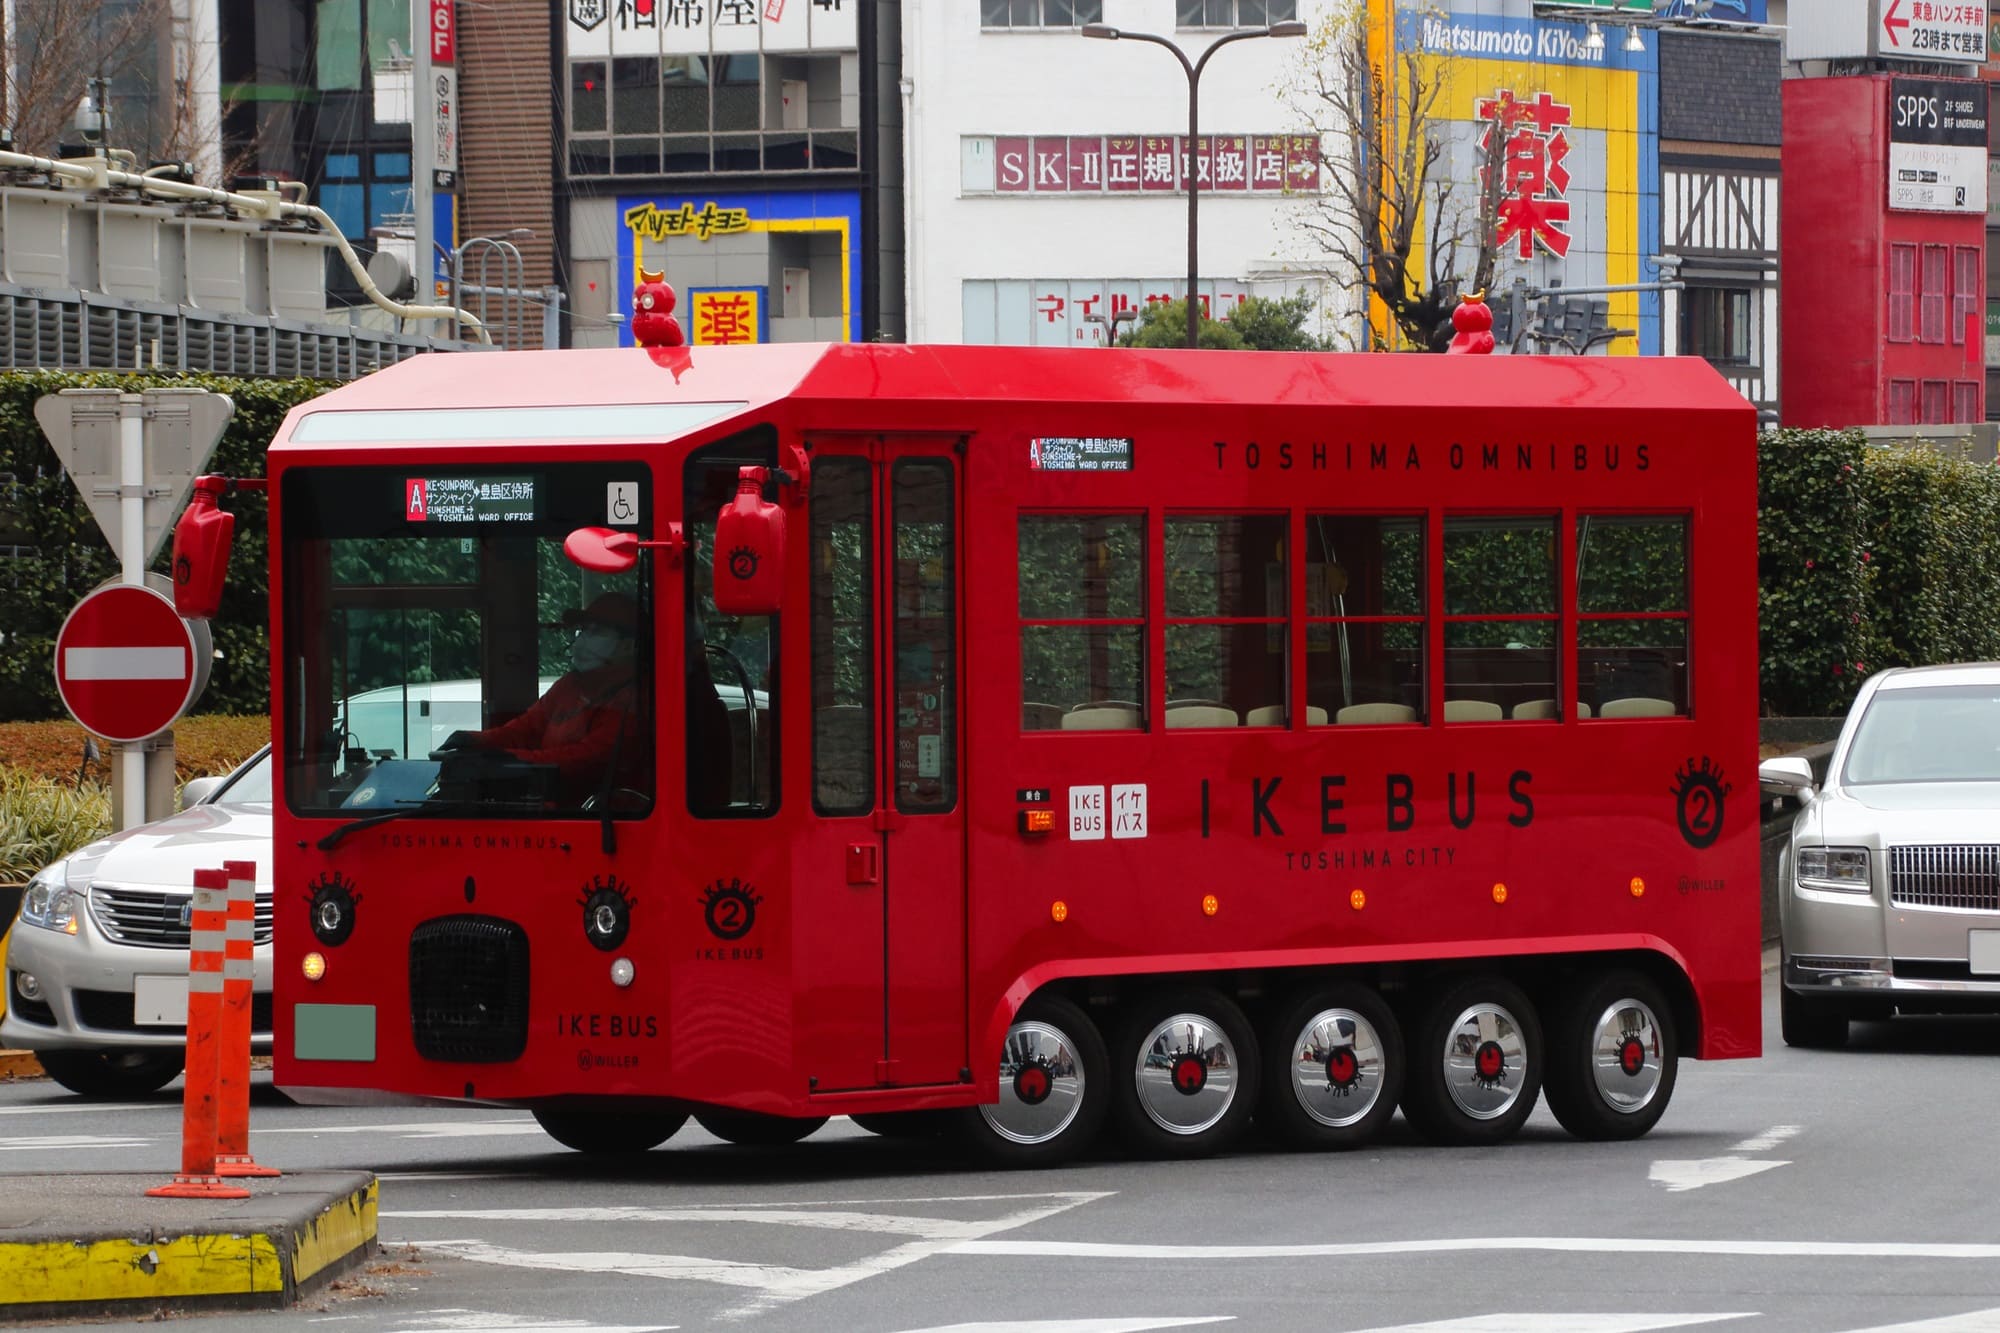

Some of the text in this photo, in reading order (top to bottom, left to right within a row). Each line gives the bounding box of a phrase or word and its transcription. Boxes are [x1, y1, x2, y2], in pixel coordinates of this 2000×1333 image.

[1912, 2, 1984, 26] 東急ハンズ手前
[1423, 18, 1533, 55] Matsumoto
[1912, 28, 1983, 54] 23時まで営業
[1897, 95, 1974, 128] SPPS 2F SHOES
[1476, 88, 1571, 261] 薬
[700, 294, 751, 345] 薬
[1213, 442, 1650, 471] TOSHIMA OMNIBUS
[410, 484, 423, 513] A
[426, 492, 475, 504] サンシャイン
[480, 483, 533, 500] 豊島区役所
[426, 506, 465, 514] SUNSHINE
[479, 513, 500, 521] WARD
[504, 513, 533, 521] OFFICE
[1074, 794, 1101, 809] IKE
[1116, 790, 1142, 809] イケ
[1692, 789, 1710, 829] 2
[1074, 816, 1101, 832] BUS
[1116, 813, 1143, 832] バス
[381, 834, 558, 849] TOSHIMA OMNIBUS
[1286, 848, 1457, 870] TOSHIMA CITY
[721, 901, 740, 927] 2
